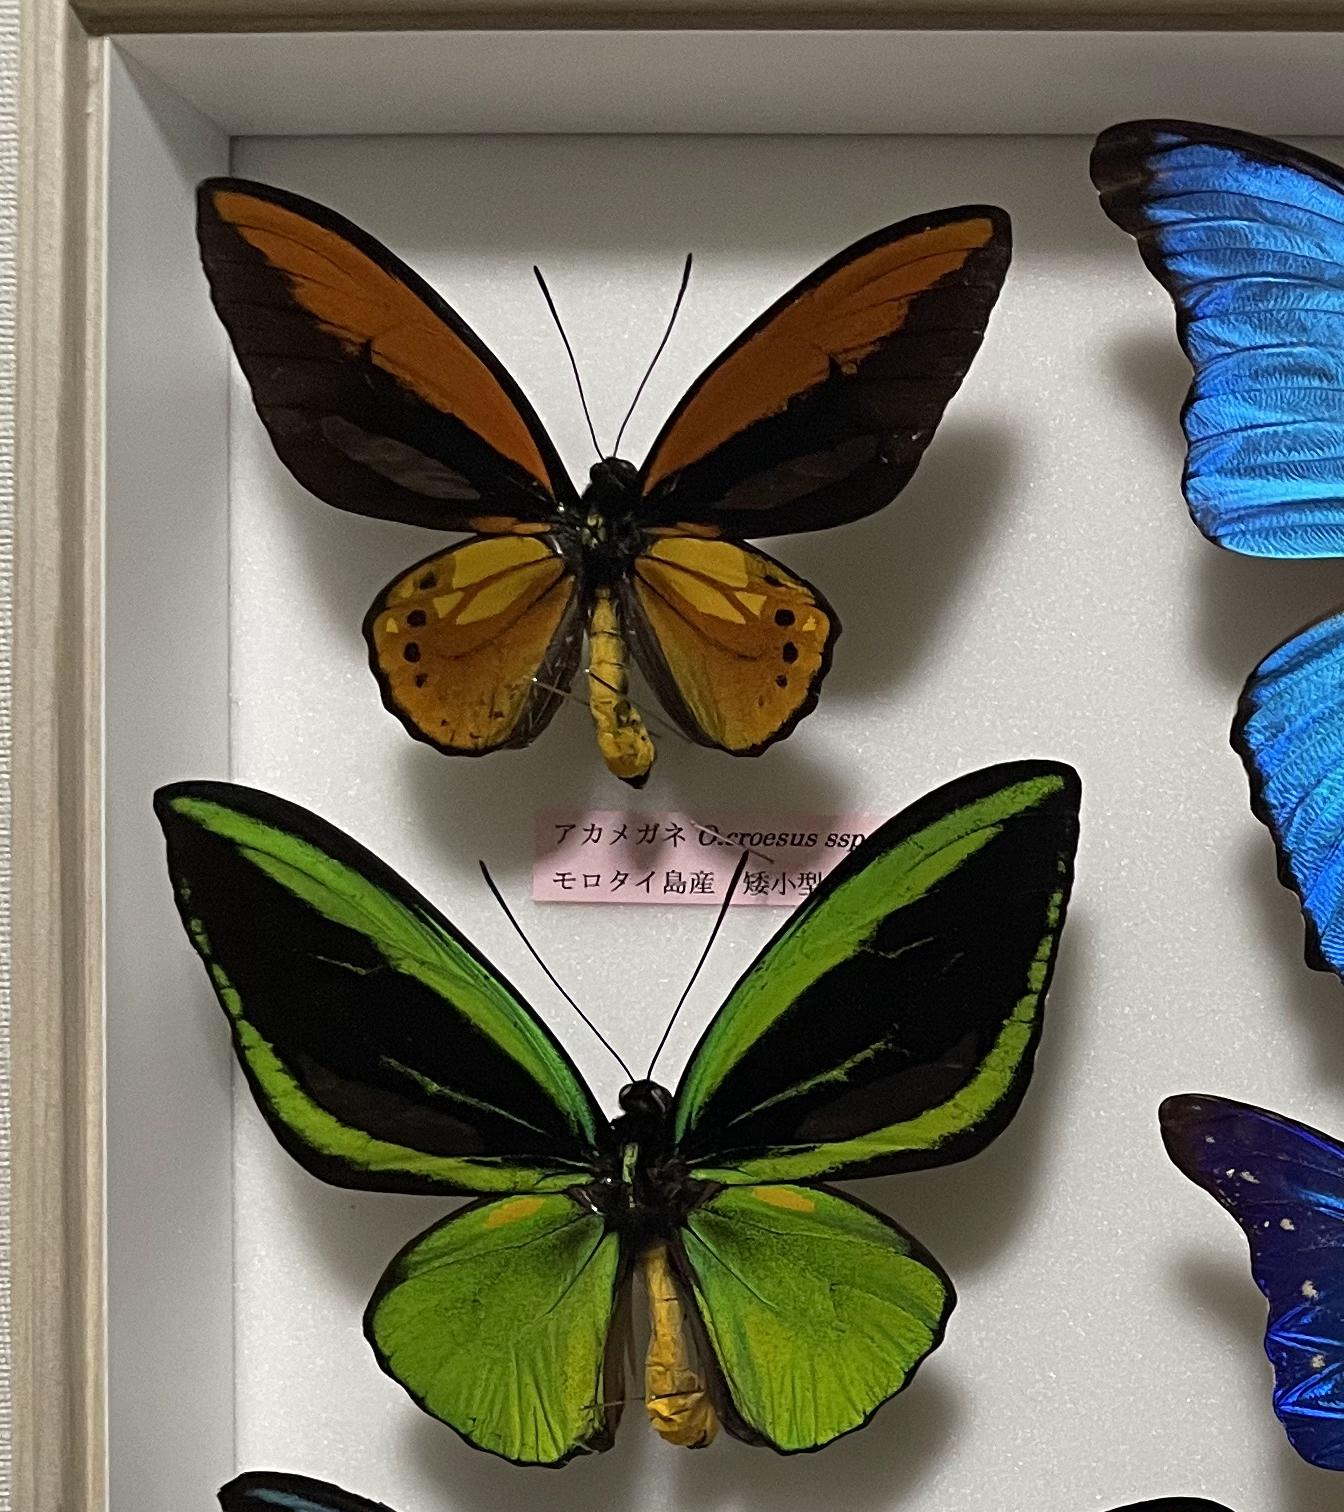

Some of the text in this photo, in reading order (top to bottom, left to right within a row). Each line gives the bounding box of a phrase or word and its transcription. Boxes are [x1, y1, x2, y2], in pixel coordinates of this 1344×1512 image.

[554, 821, 687, 849] アカメガネ
[552, 868, 716, 897] モロタイ島産
